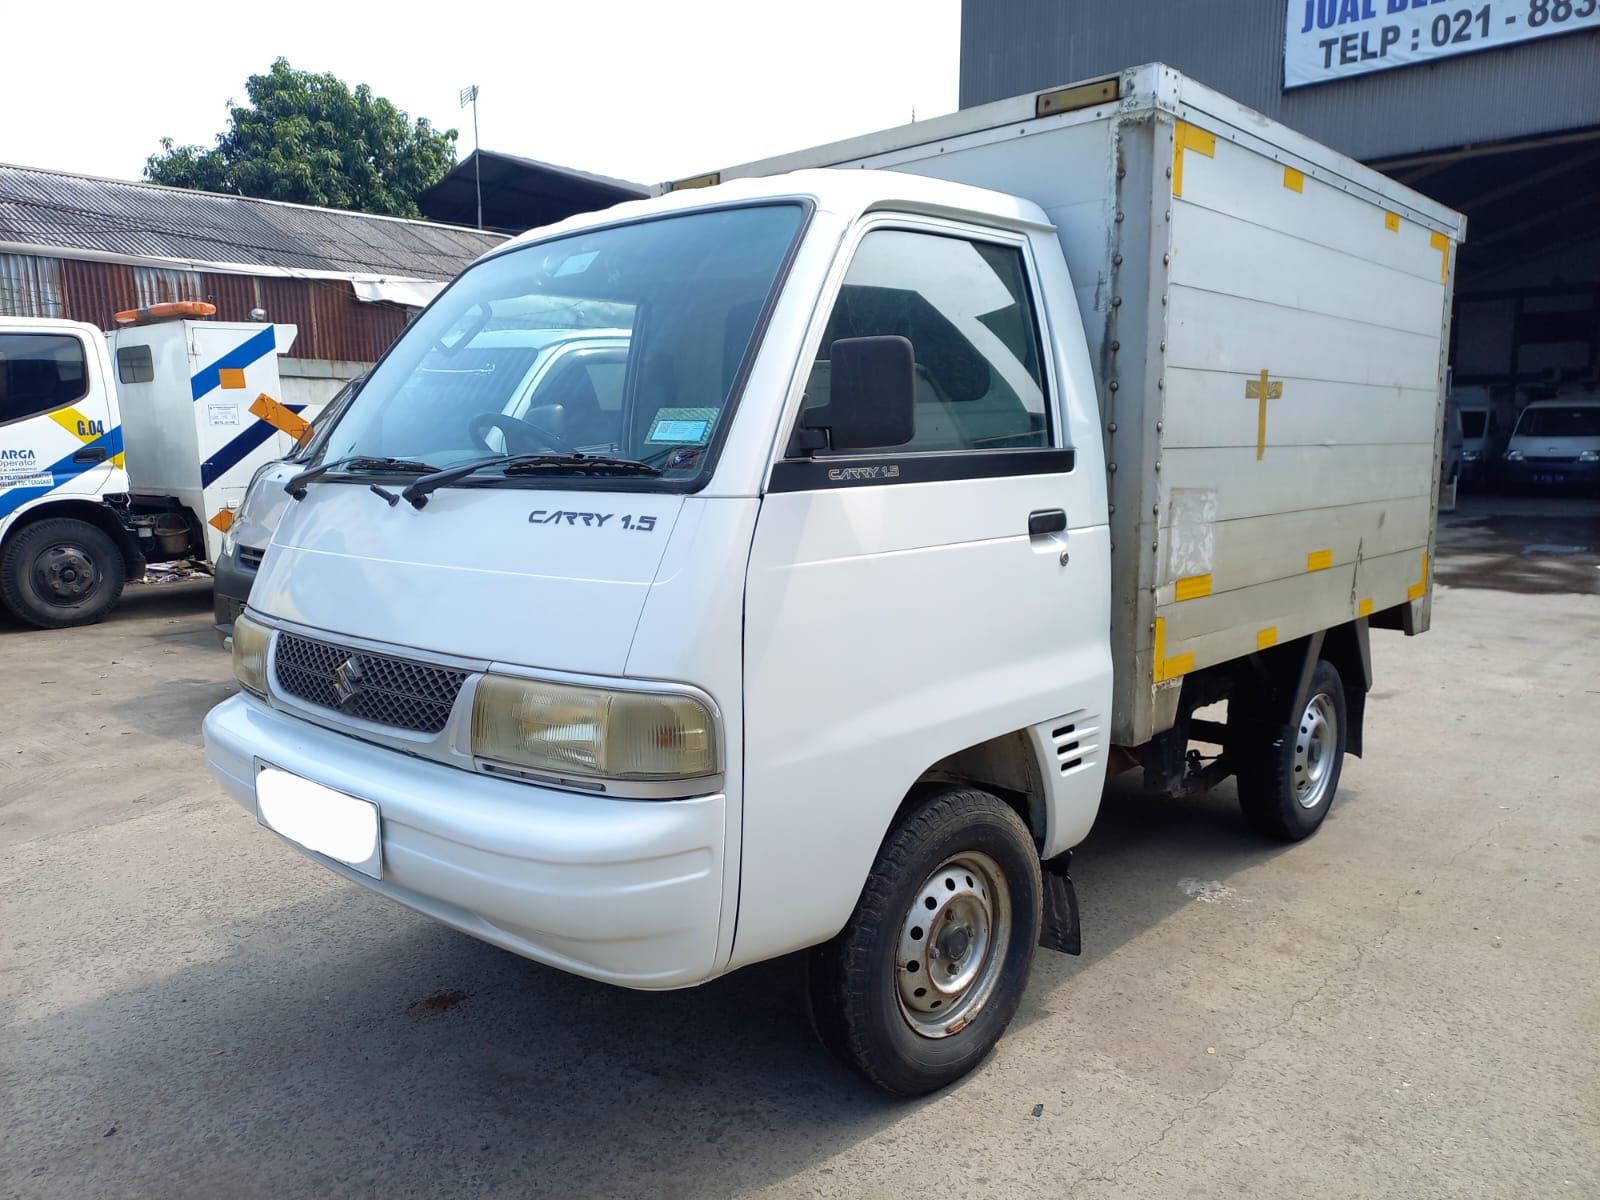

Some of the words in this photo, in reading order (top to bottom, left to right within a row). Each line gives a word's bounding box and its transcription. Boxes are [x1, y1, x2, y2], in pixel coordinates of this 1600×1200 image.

[1319, 25, 1400, 69] TELP
[1431, 4, 1491, 47] 021
[1528, 0, 1600, 27] 883
[77, 419, 104, 436] G.04
[828, 467, 879, 480] CARRY
[528, 510, 614, 527] CARRY
[620, 514, 657, 531] 1.5
